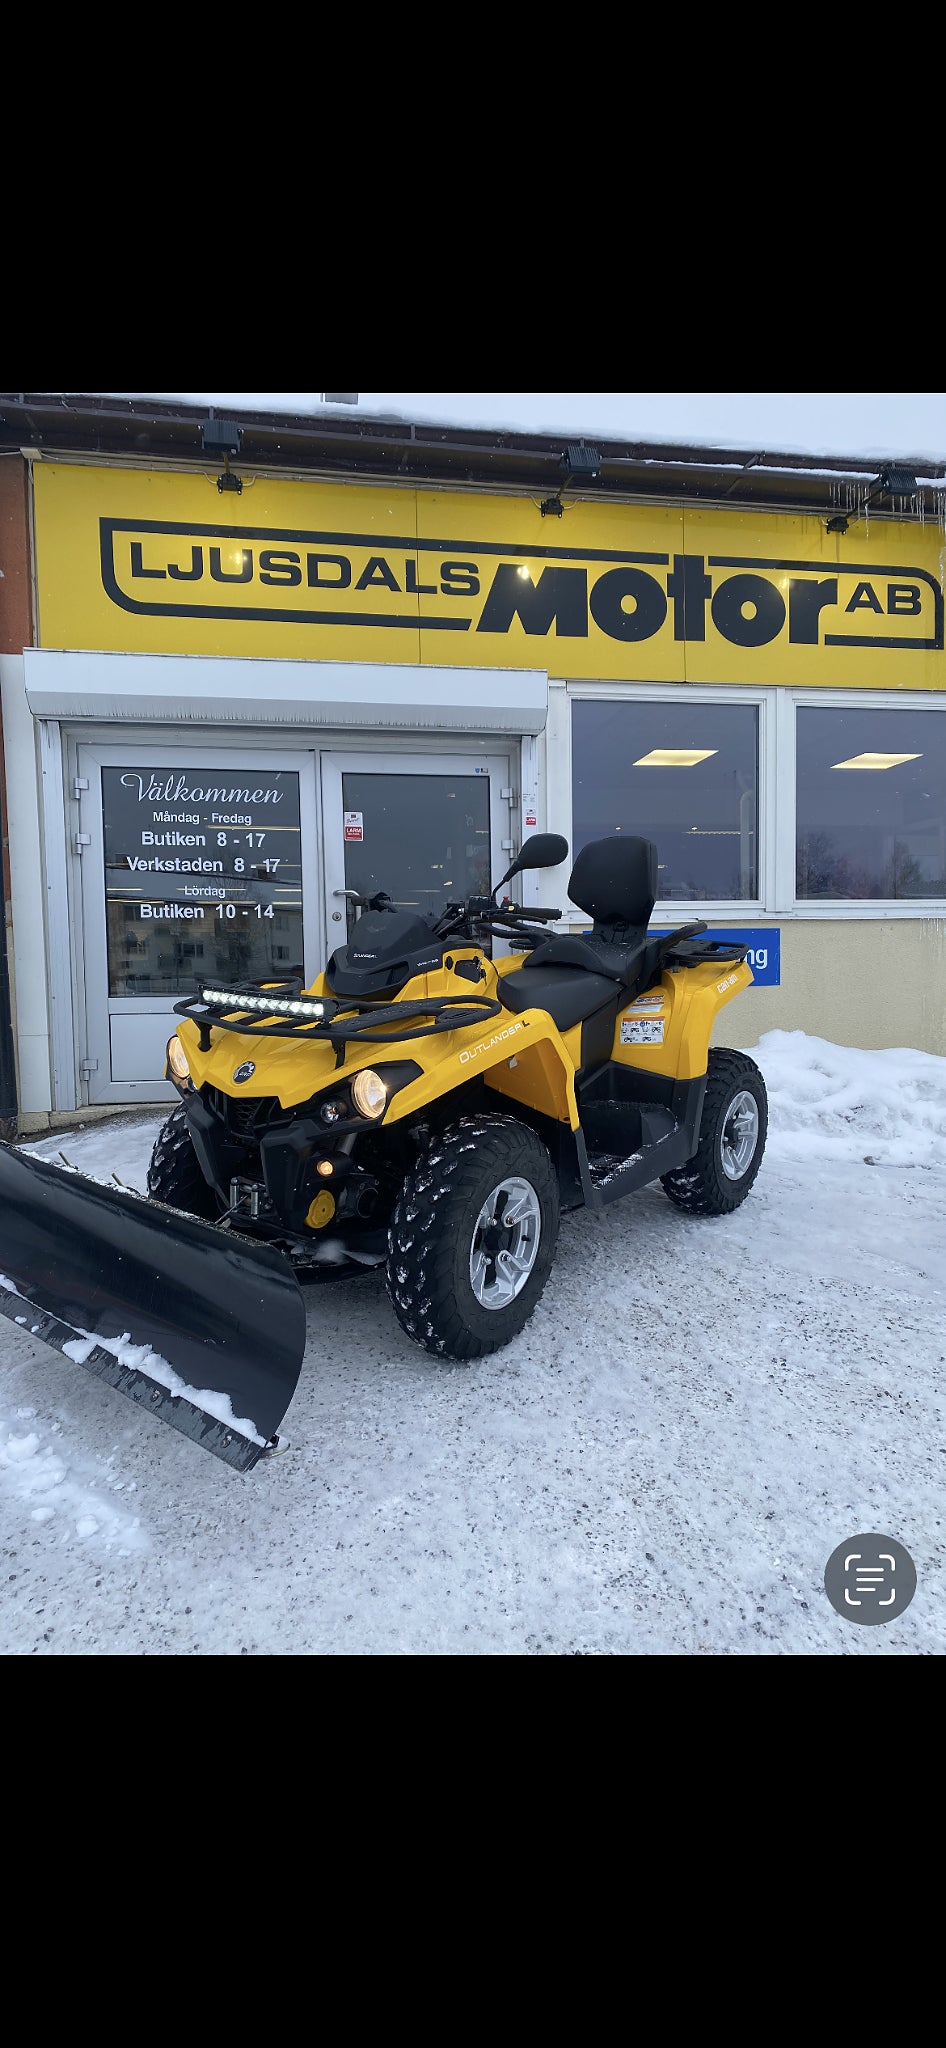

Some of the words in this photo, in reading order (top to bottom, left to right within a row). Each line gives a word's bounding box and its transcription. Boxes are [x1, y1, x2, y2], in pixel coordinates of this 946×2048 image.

[130, 541, 481, 597] LJUSDALS
[844, 582, 923, 616] AB
[120, 773, 284, 804] Välkommen
[152, 811, 200, 825] Måndag
[211, 812, 252, 826] Fredag
[141, 831, 206, 847] Butiken
[216, 831, 227, 847] 8
[245, 832, 266, 848] 17
[126, 856, 223, 872] Verkstaden
[233, 857, 245, 873] 8
[262, 858, 281, 873] 17
[184, 885, 226, 898] Lördag
[140, 903, 205, 919] Butiken
[215, 903, 236, 919] 10
[254, 904, 275, 919] 14
